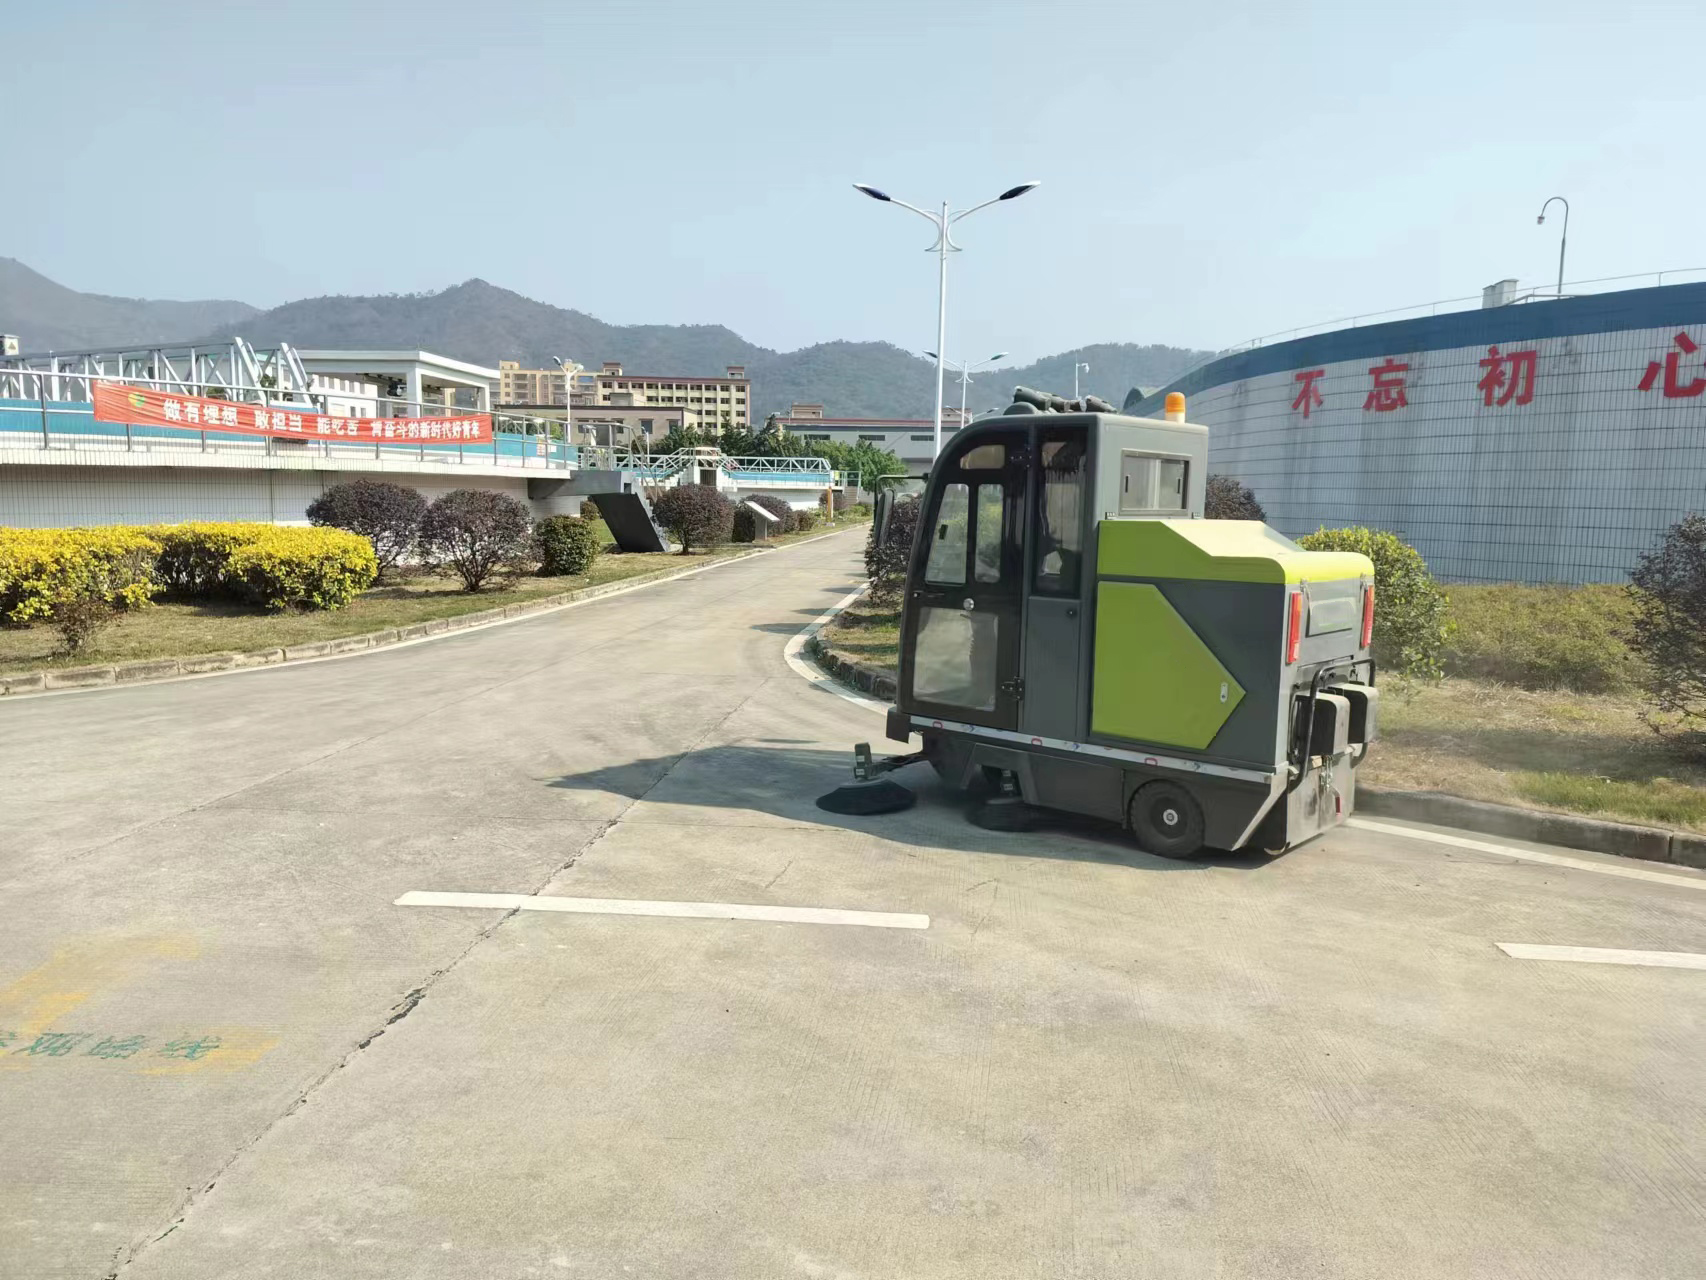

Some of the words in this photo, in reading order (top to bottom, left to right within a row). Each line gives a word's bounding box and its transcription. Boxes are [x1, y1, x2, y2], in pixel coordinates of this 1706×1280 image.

[1292, 331, 1706, 418] 不忘初心
[163, 399, 240, 426] 做有理想
[255, 408, 303, 432] 敢担当
[317, 417, 359, 436] 能吃苦
[371, 420, 481, 440] 肯奋斗的新时代好青年
